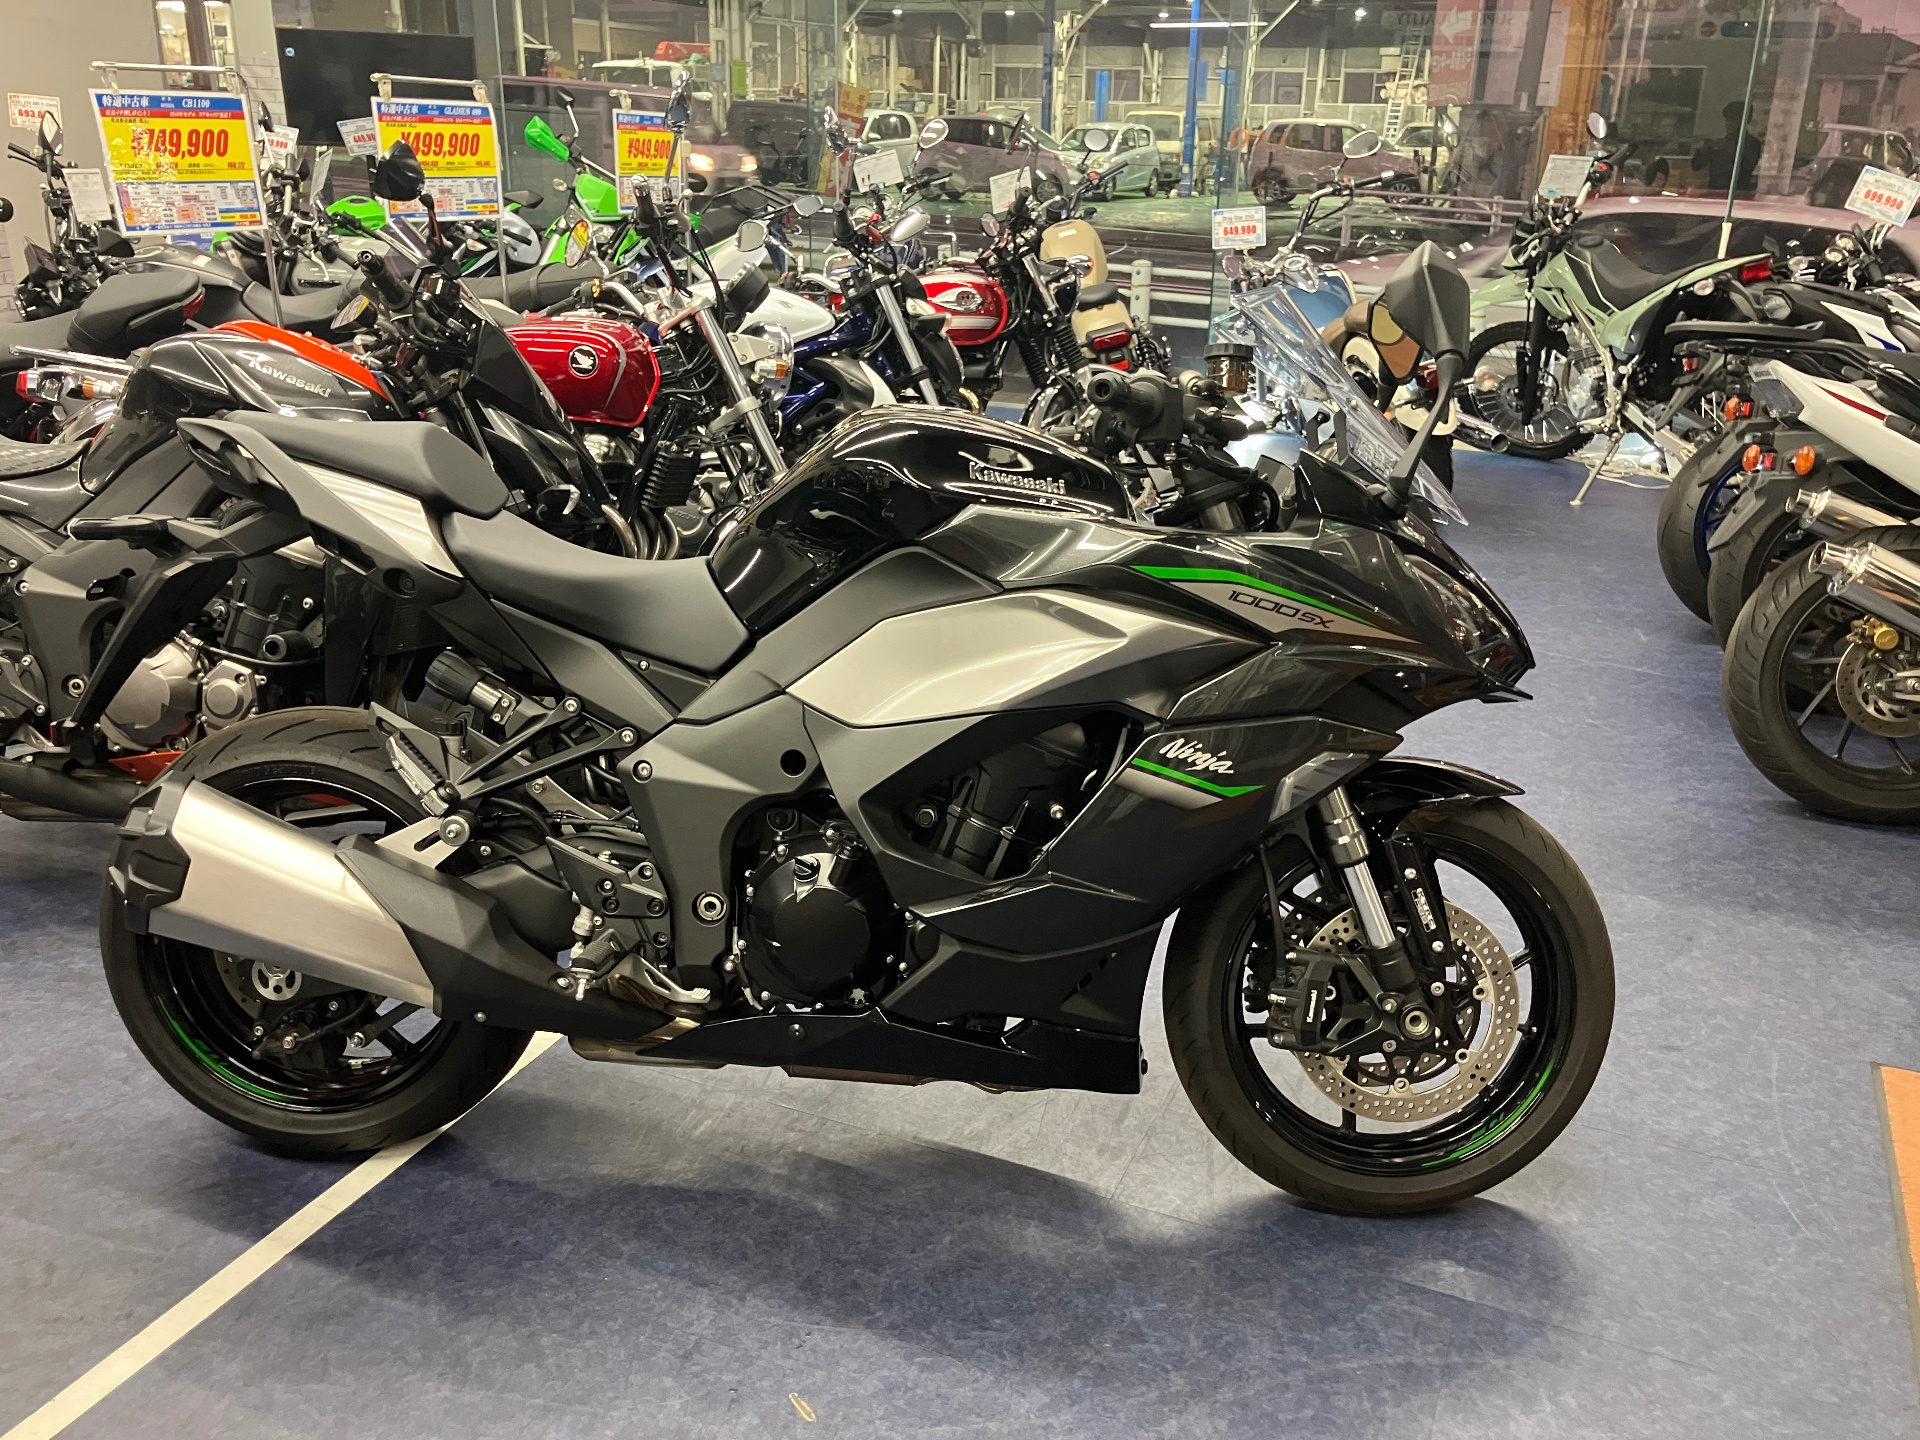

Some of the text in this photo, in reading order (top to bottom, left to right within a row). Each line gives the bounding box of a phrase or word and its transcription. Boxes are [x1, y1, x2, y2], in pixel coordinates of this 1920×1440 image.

[102, 94, 149, 108] 特選中古車
[182, 98, 211, 109] CB1100
[131, 128, 229, 160] ¥749,900
[627, 137, 671, 160] ¥949,900
[1864, 189, 1904, 210] 699,900
[1223, 224, 1257, 236] 649,900
[248, 359, 332, 398] Kawasaki
[969, 461, 1066, 495] Kawasaki
[1159, 738, 1234, 774] Ninja
